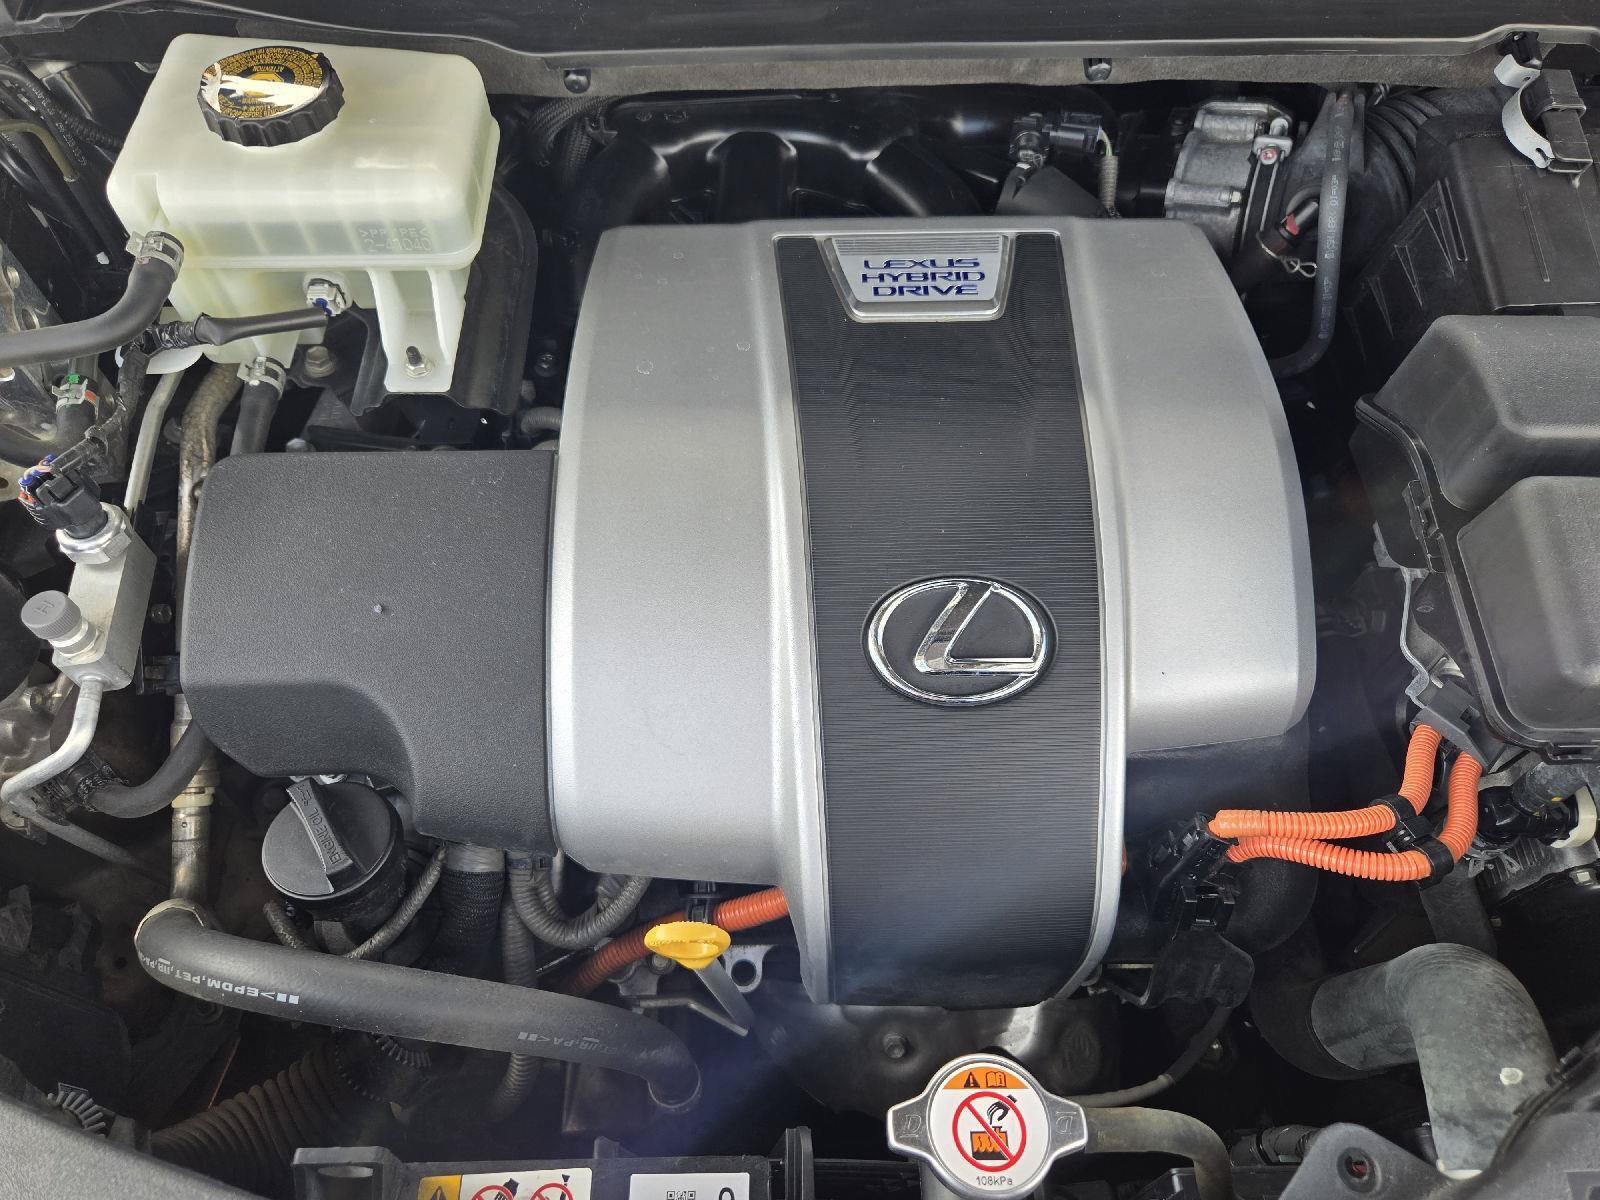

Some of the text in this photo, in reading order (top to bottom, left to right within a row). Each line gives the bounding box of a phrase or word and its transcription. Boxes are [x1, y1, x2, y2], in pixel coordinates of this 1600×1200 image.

[863, 258, 980, 270] LEXUS
[861, 271, 986, 283] HYBRID
[872, 284, 979, 297] DRIVE
[308, 807, 342, 865] ENGINE OIL
[976, 1176, 1013, 1186] 108kPa
